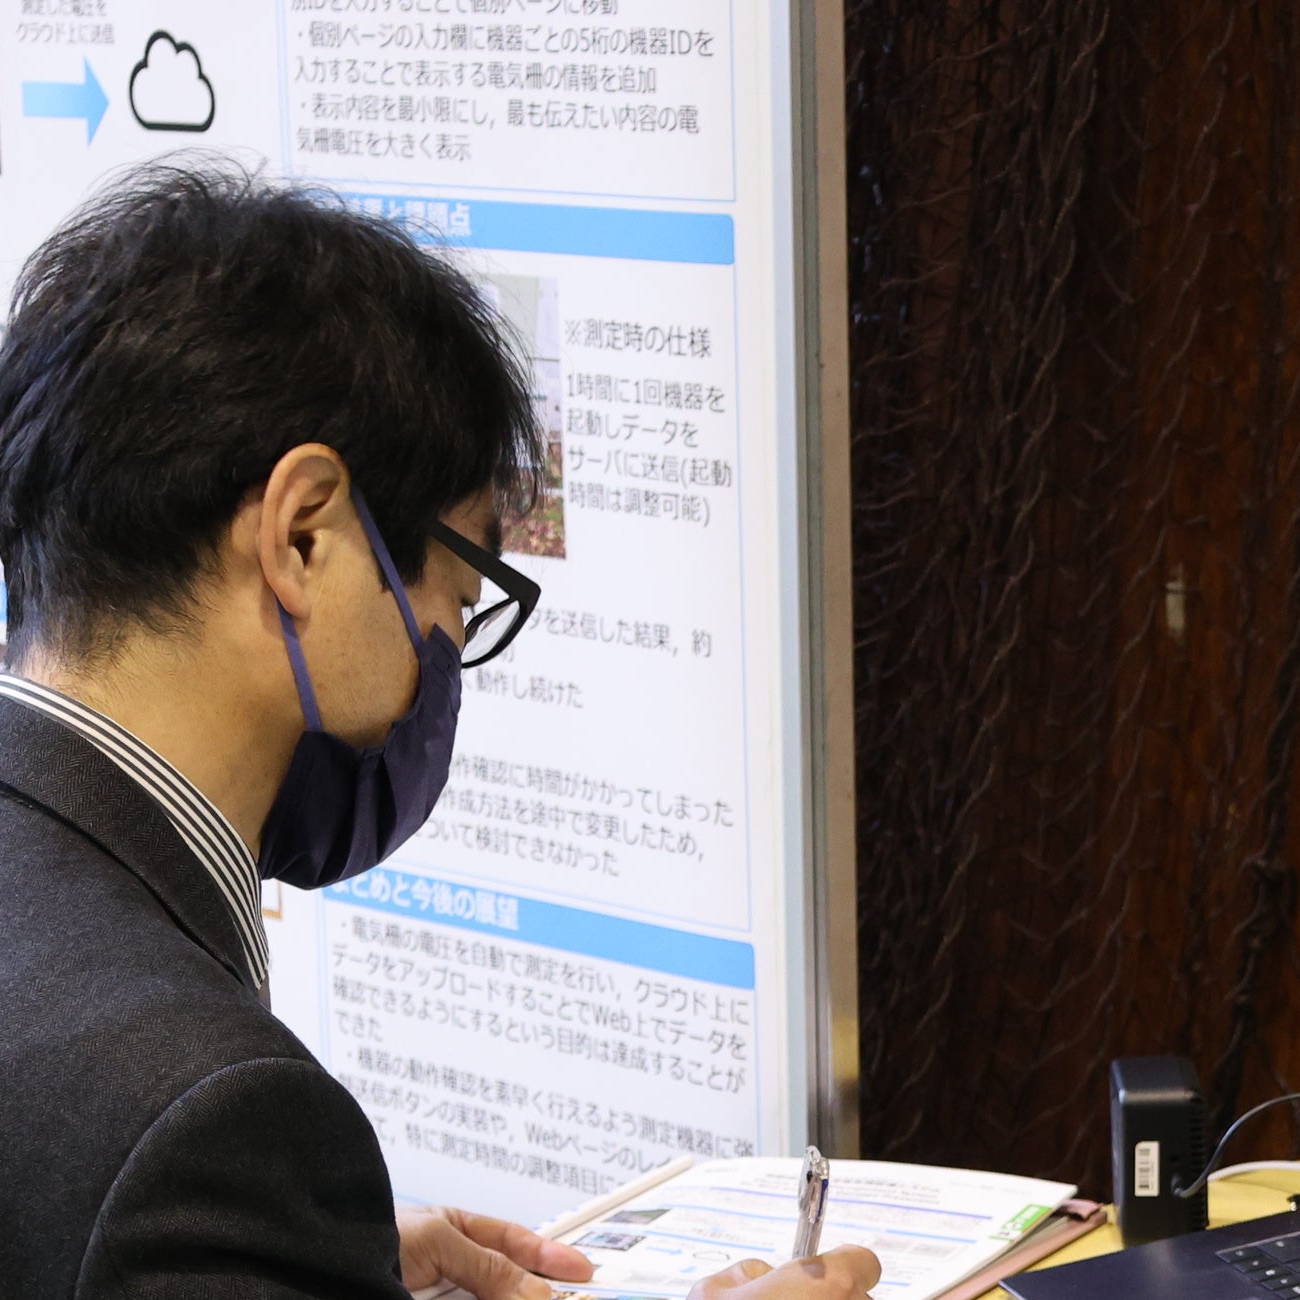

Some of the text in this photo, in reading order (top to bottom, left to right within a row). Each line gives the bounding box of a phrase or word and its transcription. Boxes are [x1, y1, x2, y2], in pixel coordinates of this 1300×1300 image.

[567, 373, 725, 412] 1時間に1回機器を
[567, 408, 700, 448] 起動しデータを
[415, 816, 620, 877] ついて検討できなかった
[338, 1009, 384, 1043] できた
